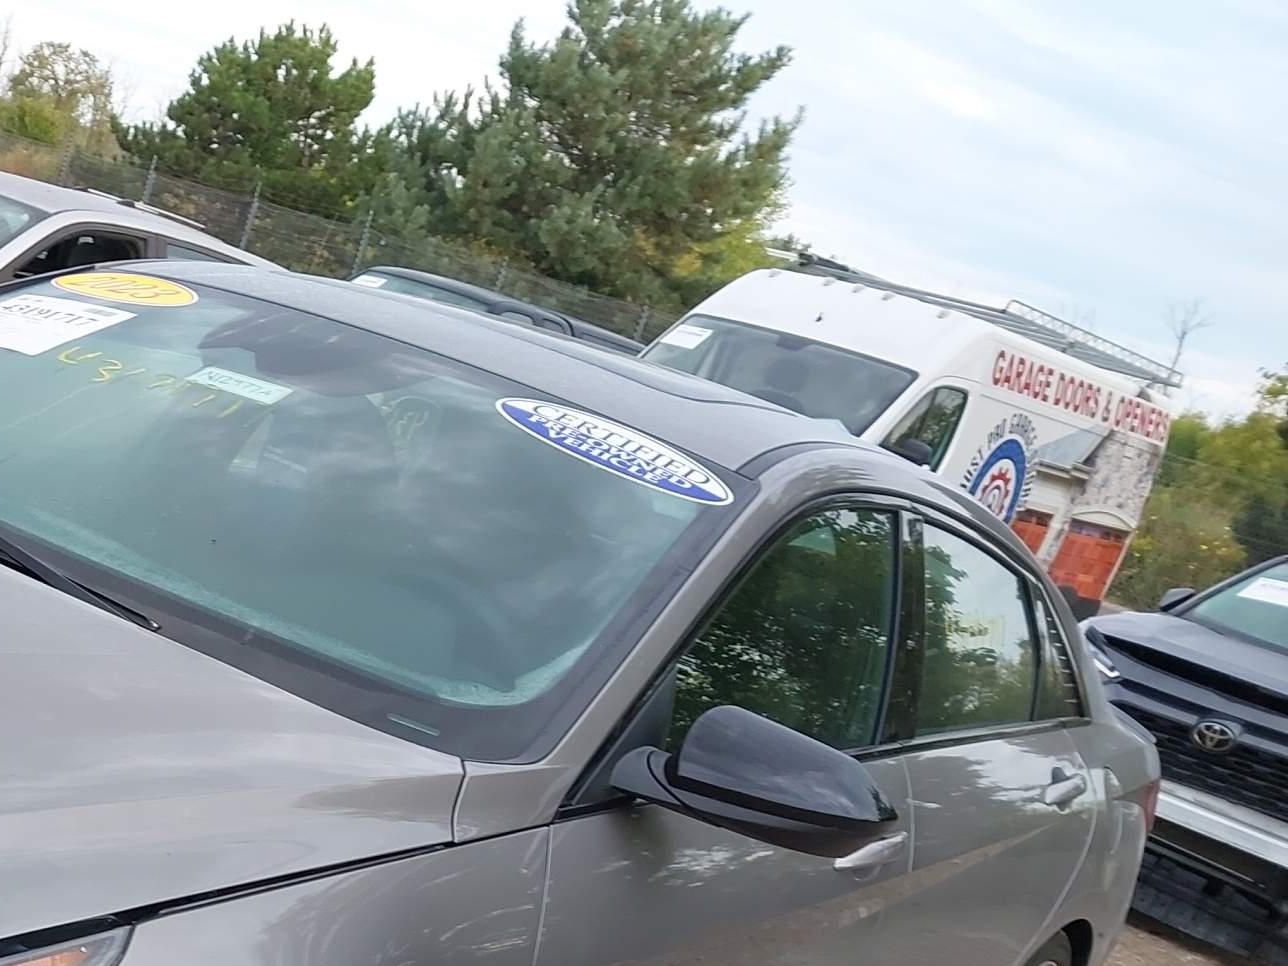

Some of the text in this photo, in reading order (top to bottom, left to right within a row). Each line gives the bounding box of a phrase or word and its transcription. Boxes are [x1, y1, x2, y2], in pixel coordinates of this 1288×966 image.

[1, 302, 98, 329] 43191717
[69, 275, 180, 301] 2023
[992, 350, 1172, 444] GARAGE DOORS & OPENERS
[527, 414, 694, 490] PRE-OWNED
[532, 404, 710, 485] CERTIFIED
[547, 428, 663, 484] VEHICLE
